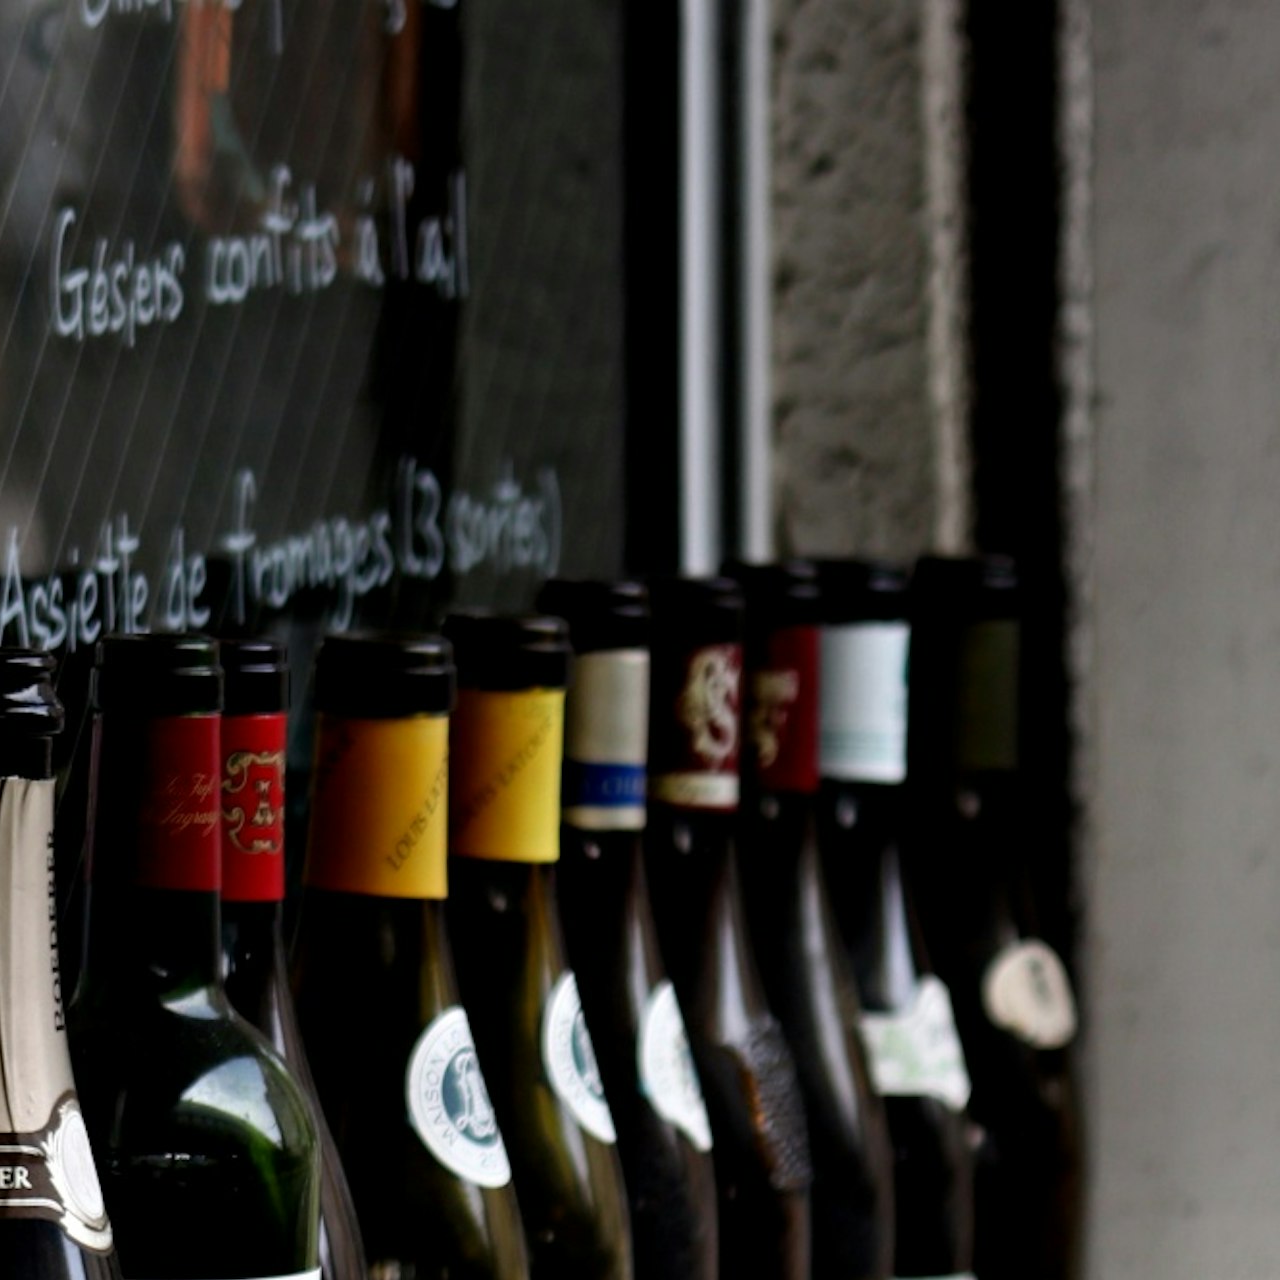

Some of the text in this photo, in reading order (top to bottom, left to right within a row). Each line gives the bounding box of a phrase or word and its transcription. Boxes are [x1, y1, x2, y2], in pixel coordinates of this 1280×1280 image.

[166, 526, 210, 630] de
[227, 468, 394, 630] fromages
[424, 1052, 459, 1147] MAISON
